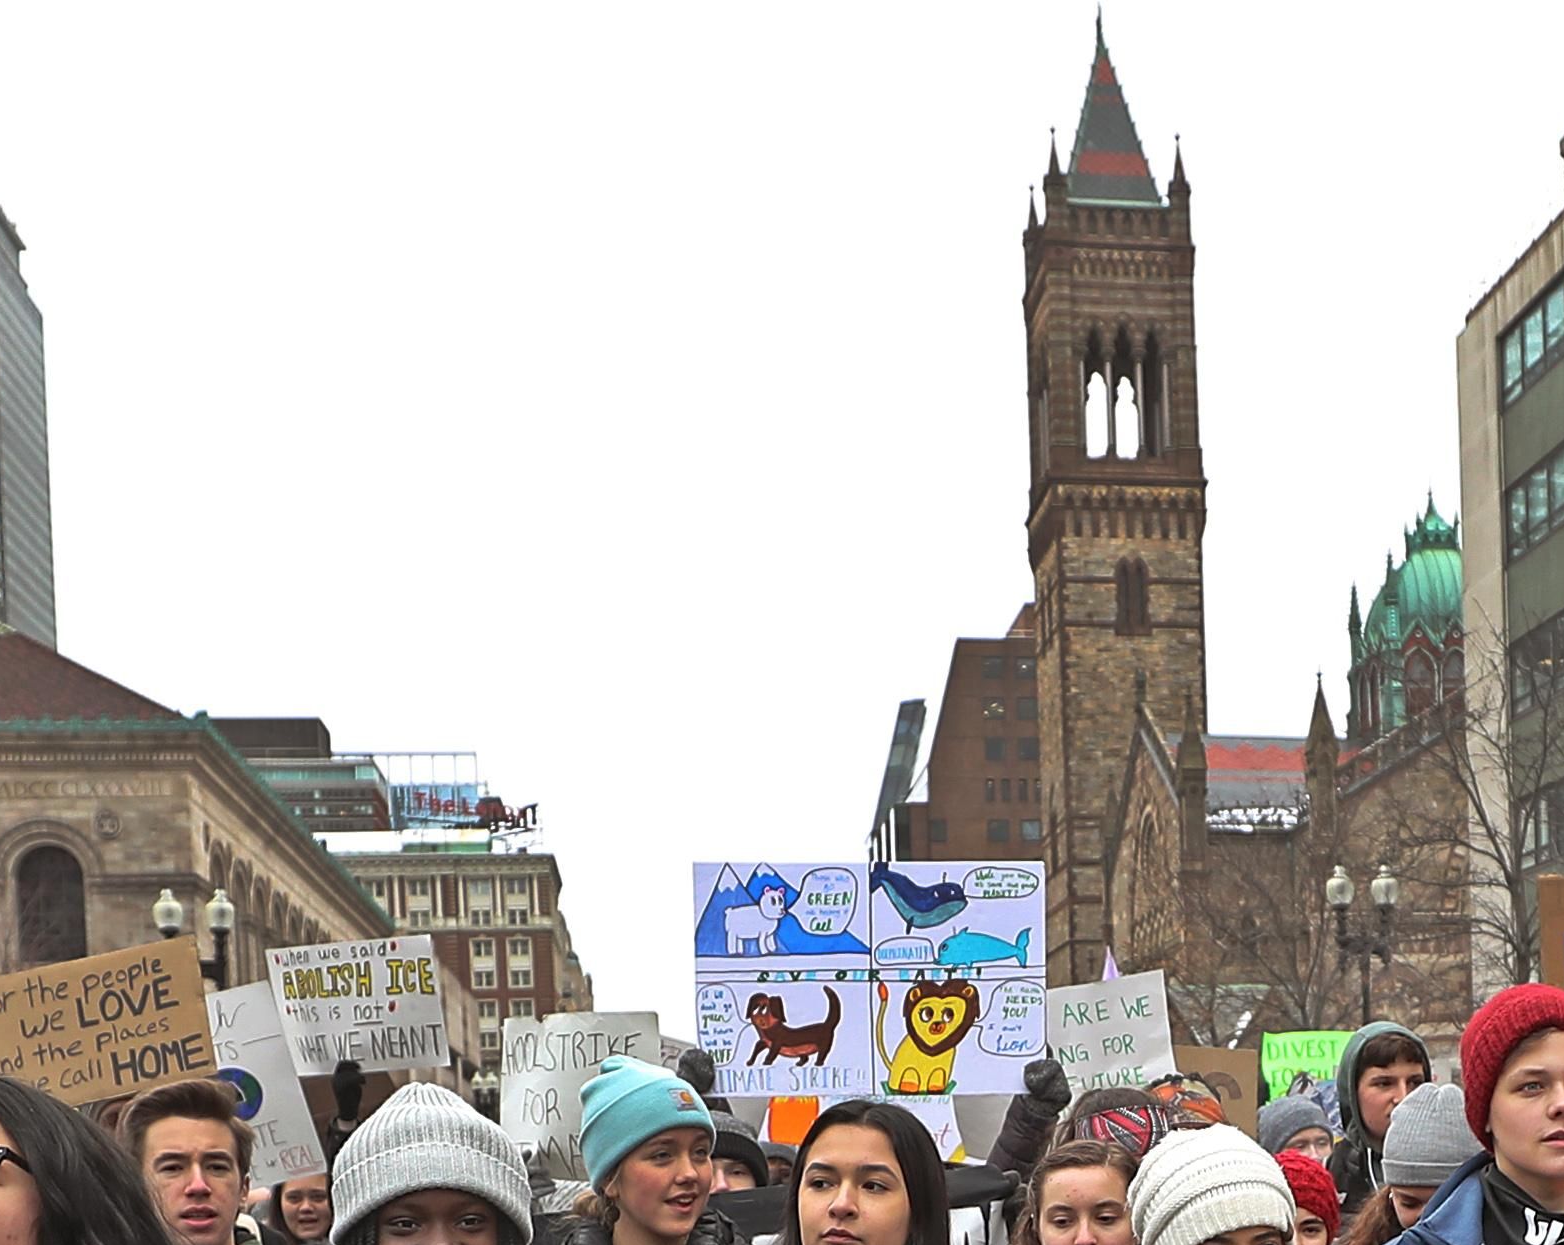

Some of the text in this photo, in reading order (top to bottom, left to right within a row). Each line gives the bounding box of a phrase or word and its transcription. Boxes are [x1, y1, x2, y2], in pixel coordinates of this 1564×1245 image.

[807, 890, 853, 906] GREEN
[350, 941, 386, 957] said
[23, 975, 69, 1008] the
[81, 957, 163, 1003] people
[282, 957, 436, 1001] ABOLISH ICE
[756, 970, 817, 983] SAVE
[20, 1009, 65, 1039] we
[76, 975, 180, 1029] LOVE
[293, 1001, 384, 1023] this is not
[1005, 995, 1043, 1006] NEEDS
[1062, 995, 1154, 1028] ARE WE
[32, 1039, 83, 1067] the
[95, 1016, 171, 1053] places
[294, 1035, 331, 1064] WHAT
[371, 1024, 443, 1061] MEANT
[502, 1030, 643, 1077] HOOLSTRIKE
[1102, 1034, 1136, 1056] FOR
[1266, 1038, 1339, 1061] DIVEST
[109, 1033, 211, 1086] HOME
[522, 1087, 562, 1126] FOR
[279, 1145, 324, 1171] REAL
